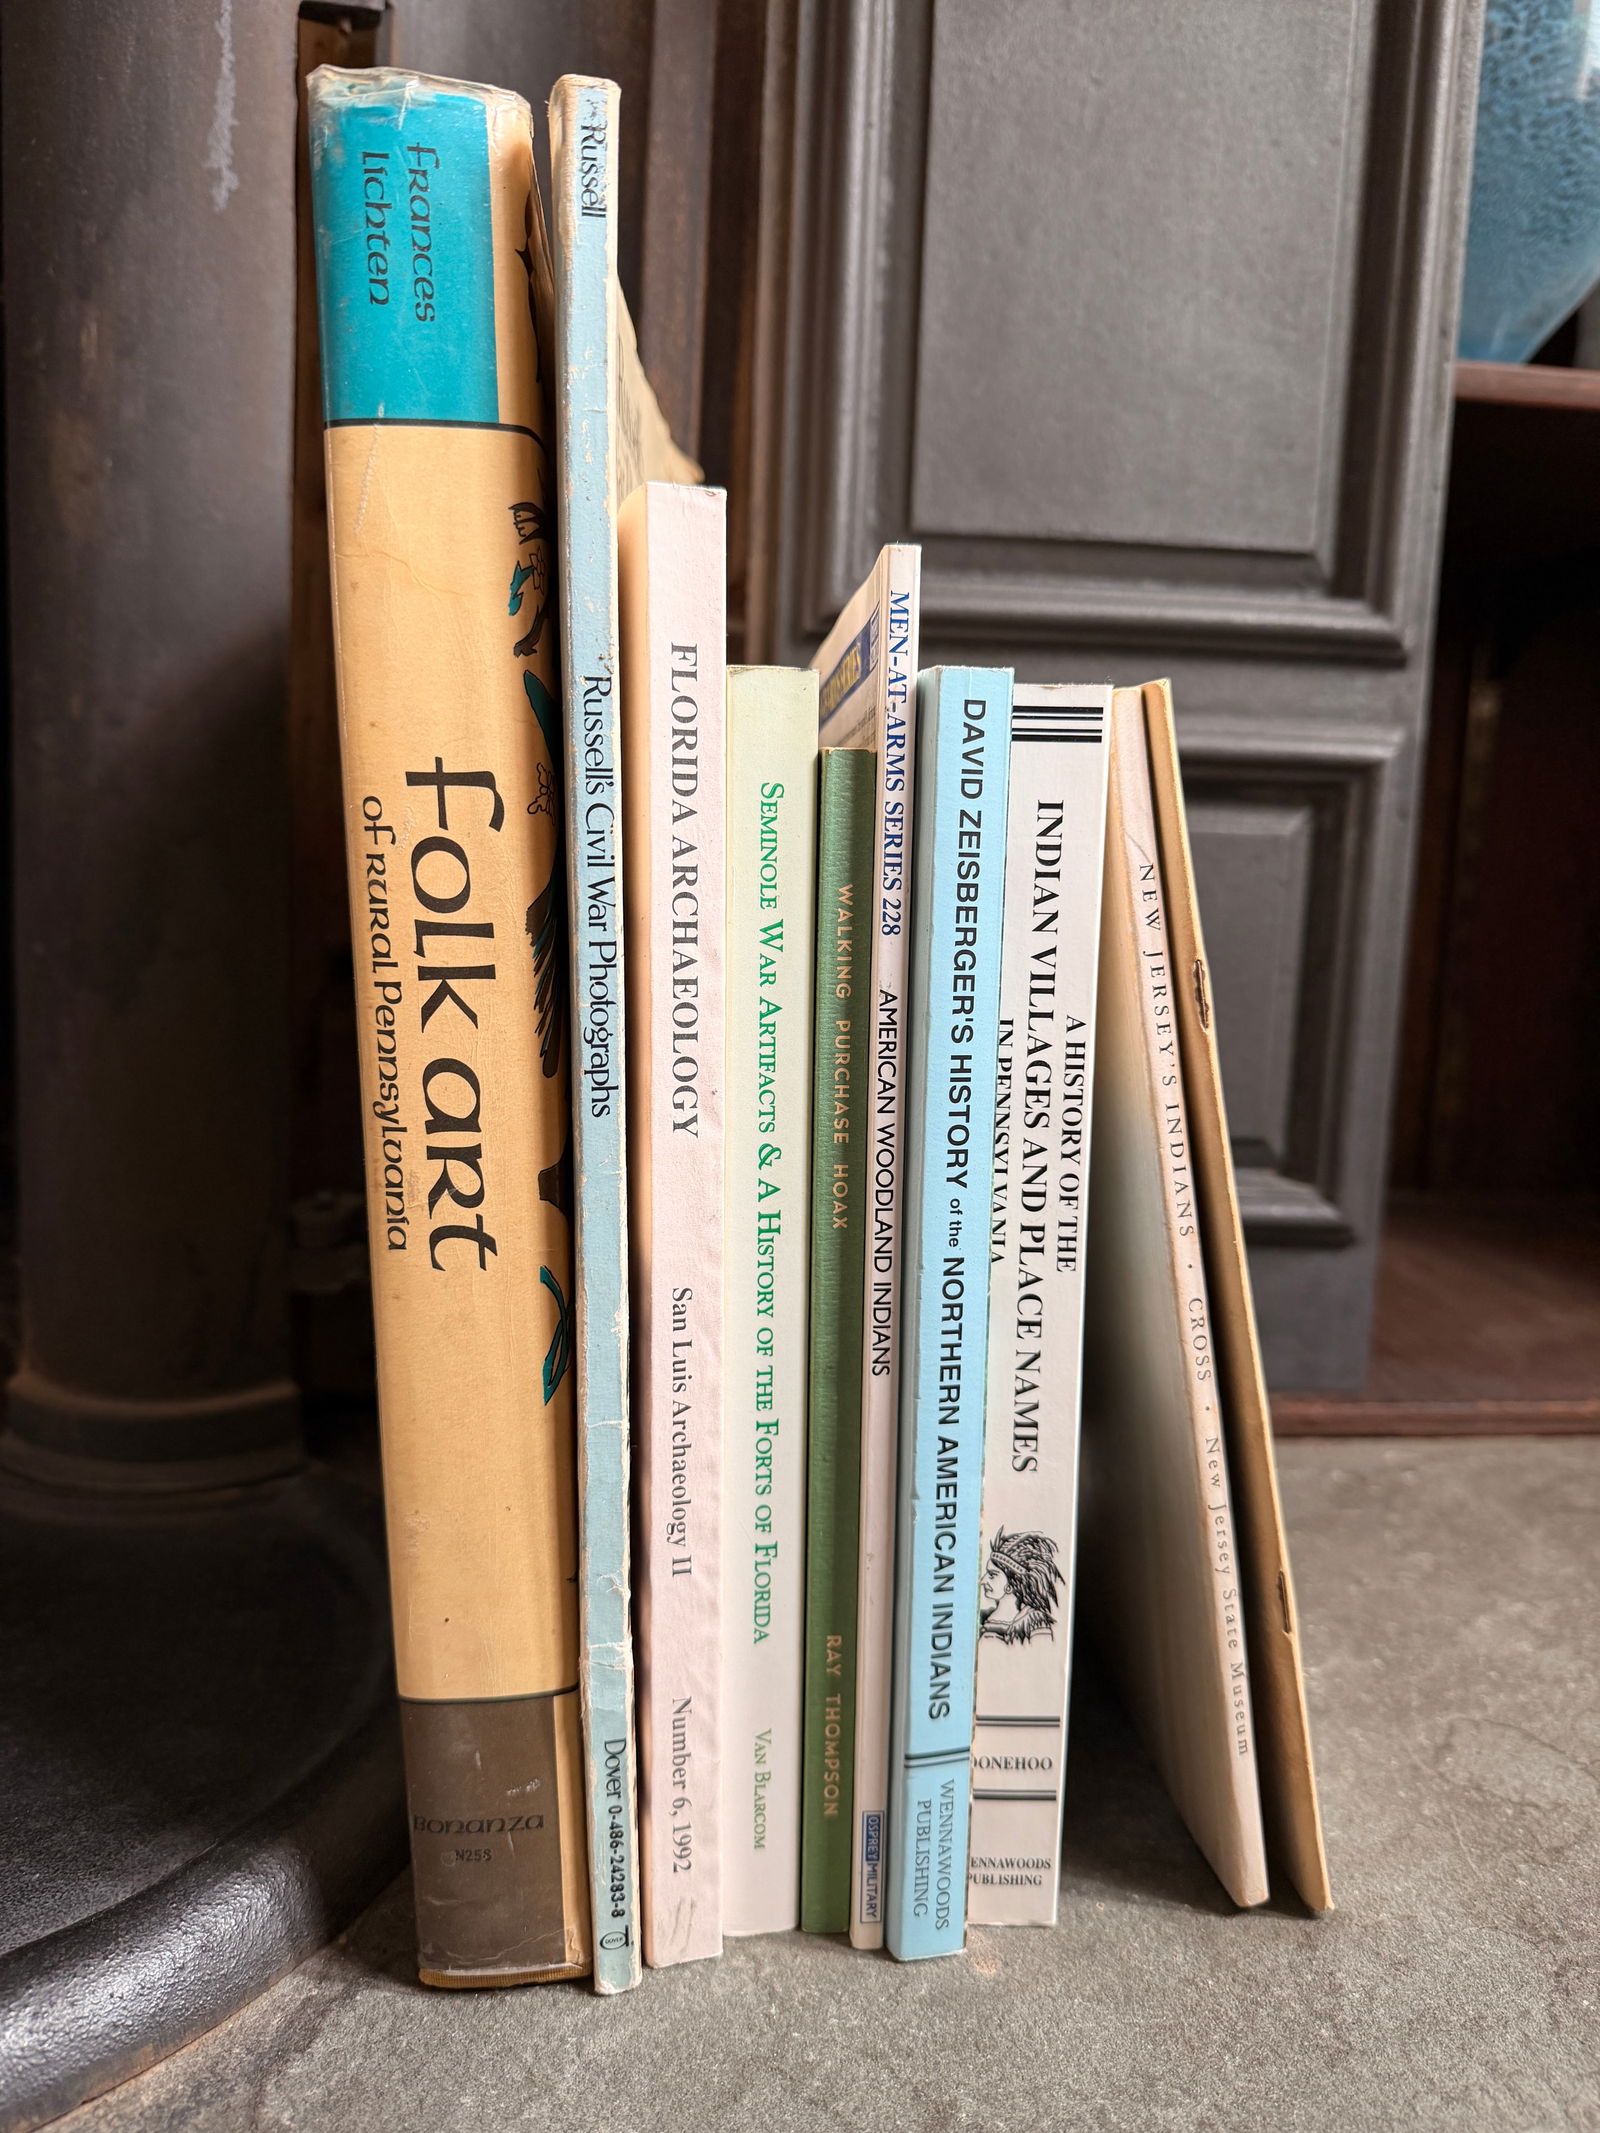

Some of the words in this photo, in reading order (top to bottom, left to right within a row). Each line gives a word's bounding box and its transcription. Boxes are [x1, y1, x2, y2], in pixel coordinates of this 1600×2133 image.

[580, 124, 607, 218] Russell
[583, 676, 614, 795] Russell's
[671, 642, 698, 825] FLORIDA
[885, 590, 910, 792] MEN-AT-ARMS
[960, 699, 986, 799] DAVID
[362, 795, 397, 845] of
[586, 802, 615, 867] Civil
[882, 801, 904, 891] SERIES
[587, 876, 616, 932] War
[1031, 799, 1064, 935] INDIAN
[1139, 864, 1161, 931] NEW
[836, 884, 854, 999] WALKING
[881, 898, 902, 936] 228
[950, 809, 982, 1044] ZEISBERGER'S
[583, 941, 619, 1118] Photographs
[672, 834, 699, 1138] ARCHAEOLOGY
[1065, 1014, 1087, 1034] A
[1143, 950, 1177, 1086] JERSEY'S
[877, 989, 898, 1114] AMERICAN
[998, 1018, 1014, 1048] IN
[1023, 945, 1058, 1129] VILLAGES
[833, 1021, 851, 1144] PURCHASE
[946, 1054, 973, 1188] HISTORY
[1058, 1041, 1086, 1165] HISTORY
[757, 1178, 781, 1202] A
[758, 1143, 782, 1170] &
[832, 1164, 849, 1229] HOAX
[873, 1123, 895, 1273] WOODLAND
[1020, 1138, 1048, 1213] AND
[1058, 1173, 1080, 1210] OF
[1165, 1103, 1194, 1237] INDIANS
[949, 1221, 963, 1248] the
[951, 1198, 963, 1215] of
[1056, 1216, 1078, 1272] THE
[672, 1287, 693, 1332] San
[1016, 1222, 1046, 1340] PLACE
[672, 1339, 693, 1393] Luis
[872, 1282, 892, 1376] INDIANS
[938, 1257, 965, 1425] NORTHERN
[1188, 1297, 1211, 1381] CROSS
[1012, 1350, 1041, 1473] NAMES
[666, 1399, 692, 1547] Archaeology
[1205, 1436, 1221, 1489] New
[932, 1435, 959, 1593] AMERICAN
[1208, 1504, 1231, 1576] Jersey
[672, 1555, 692, 1577] II
[825, 1634, 842, 1677] RAY
[928, 1602, 953, 1720] INDIANS
[1222, 1588, 1238, 1650] State
[672, 1695, 692, 1786] Number
[1230, 1662, 1249, 1756] Museum
[604, 1737, 626, 1799] Dover
[823, 1694, 842, 1816] THOMPSON
[414, 1814, 544, 1834] Bonanza
[668, 1798, 692, 1815] 6,
[672, 1824, 692, 1874] 1992
[867, 1815, 879, 1860] OSPREY
[608, 1805, 626, 1918] 0-486-24283-8
[866, 1863, 878, 1918] MILITARY
[913, 1800, 931, 1918] PUBLISHING
[935, 1778, 955, 1931] WENNAWOODS
[971, 1857, 1051, 1869] ENNAWOODS
